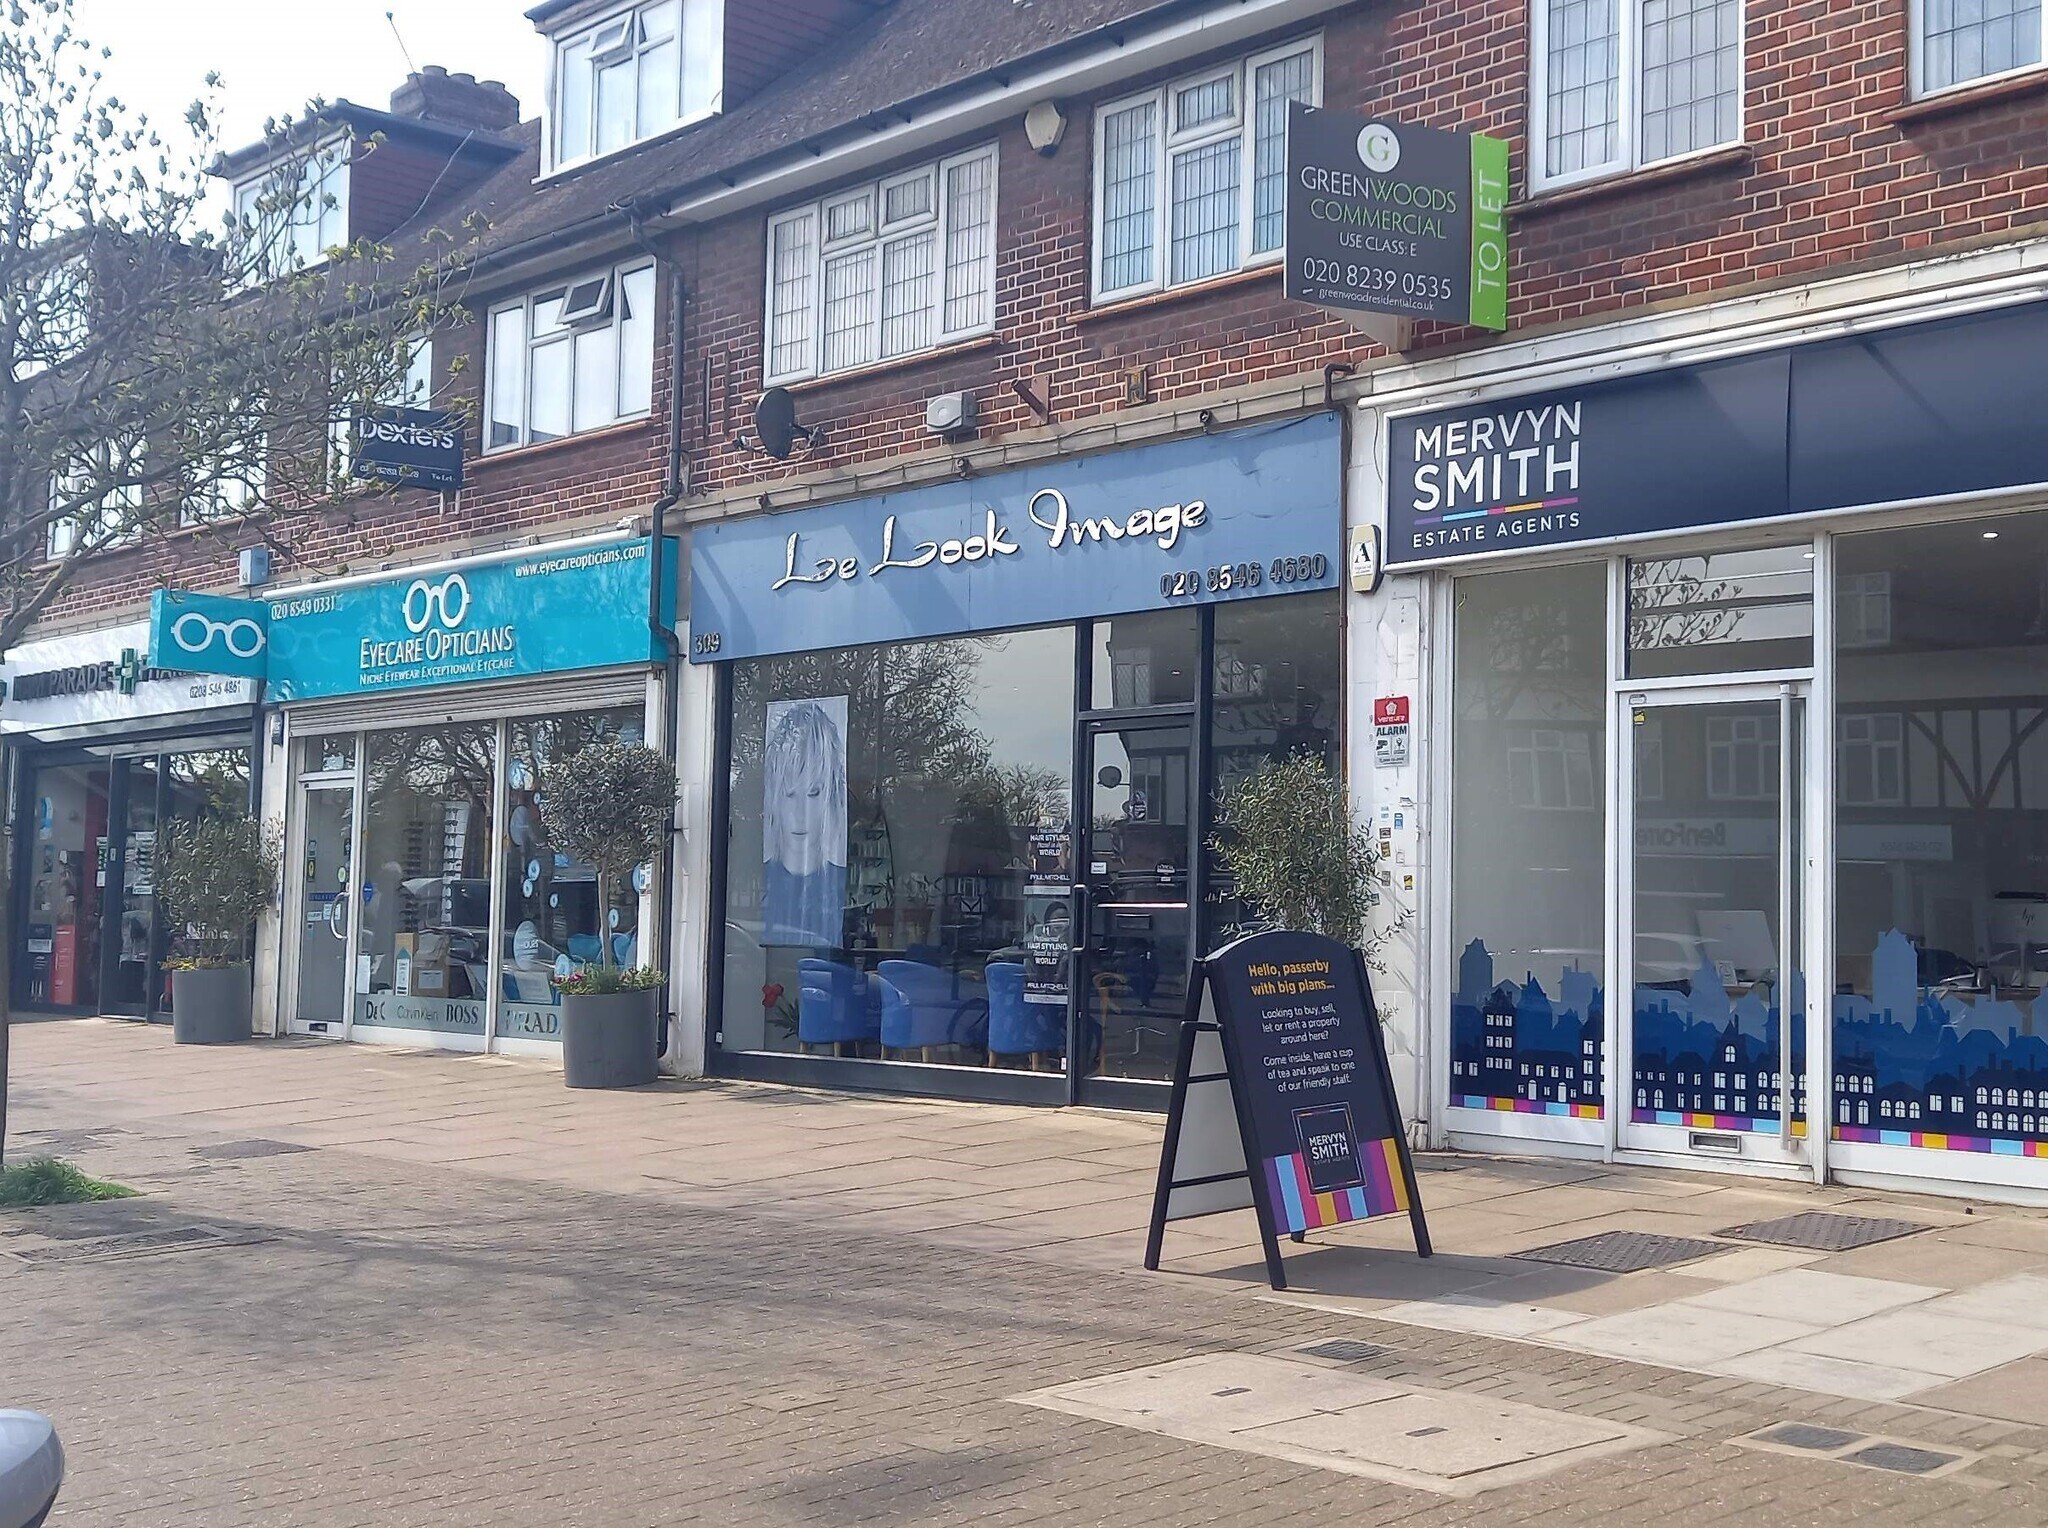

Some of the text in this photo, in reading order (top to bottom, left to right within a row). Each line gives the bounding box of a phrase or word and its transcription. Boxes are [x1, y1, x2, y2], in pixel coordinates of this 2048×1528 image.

[1366, 135, 1390, 162] G
[1300, 165, 1457, 214] GREENWOODS
[1310, 198, 1447, 240] COMMERCIAL
[1477, 168, 1502, 294] TO LET
[1339, 231, 1362, 249] USE
[1410, 242, 1417, 257] E
[1303, 257, 1452, 300] 020 8239 0535
[359, 417, 454, 449] Dexters
[1414, 400, 1582, 462] MERVYN
[1412, 440, 1580, 512] SMITH
[771, 488, 1207, 590] Le Look Image
[1412, 512, 1581, 549] ESTATE AGENTS
[514, 544, 646, 577] www.eyecareopticians.com
[1159, 552, 1327, 598] 020 8546 4680
[271, 595, 335, 621] 020 8549 0331
[425, 624, 516, 661] OPTICIANS
[694, 631, 721, 655] 309
[50, 660, 115, 697] PARADE
[1375, 725, 1408, 737] ALARM
[1248, 959, 1330, 977] Hello, passerby
[1251, 981, 1276, 995] with
[1277, 980, 1297, 995] big
[446, 1003, 480, 1026] BOSS
[505, 1008, 562, 1035] PRAD
[1261, 1008, 1294, 1019] Looking
[1294, 1006, 1303, 1016] to
[1261, 1016, 1341, 1033] let or rent a property
[1280, 1030, 1329, 1044] around here?
[1263, 1056, 1288, 1067] Come
[1313, 1050, 1332, 1061] have
[1332, 1049, 1338, 1058] a
[1338, 1048, 1354, 1059] cup
[1267, 1061, 1356, 1080] of tea and speak to one
[1277, 1081, 1287, 1092] of
[1287, 1082, 1301, 1091] our
[1302, 1076, 1332, 1089] friendly
[1308, 1131, 1347, 1147] MERVYN
[1311, 1142, 1350, 1160] SMITH
